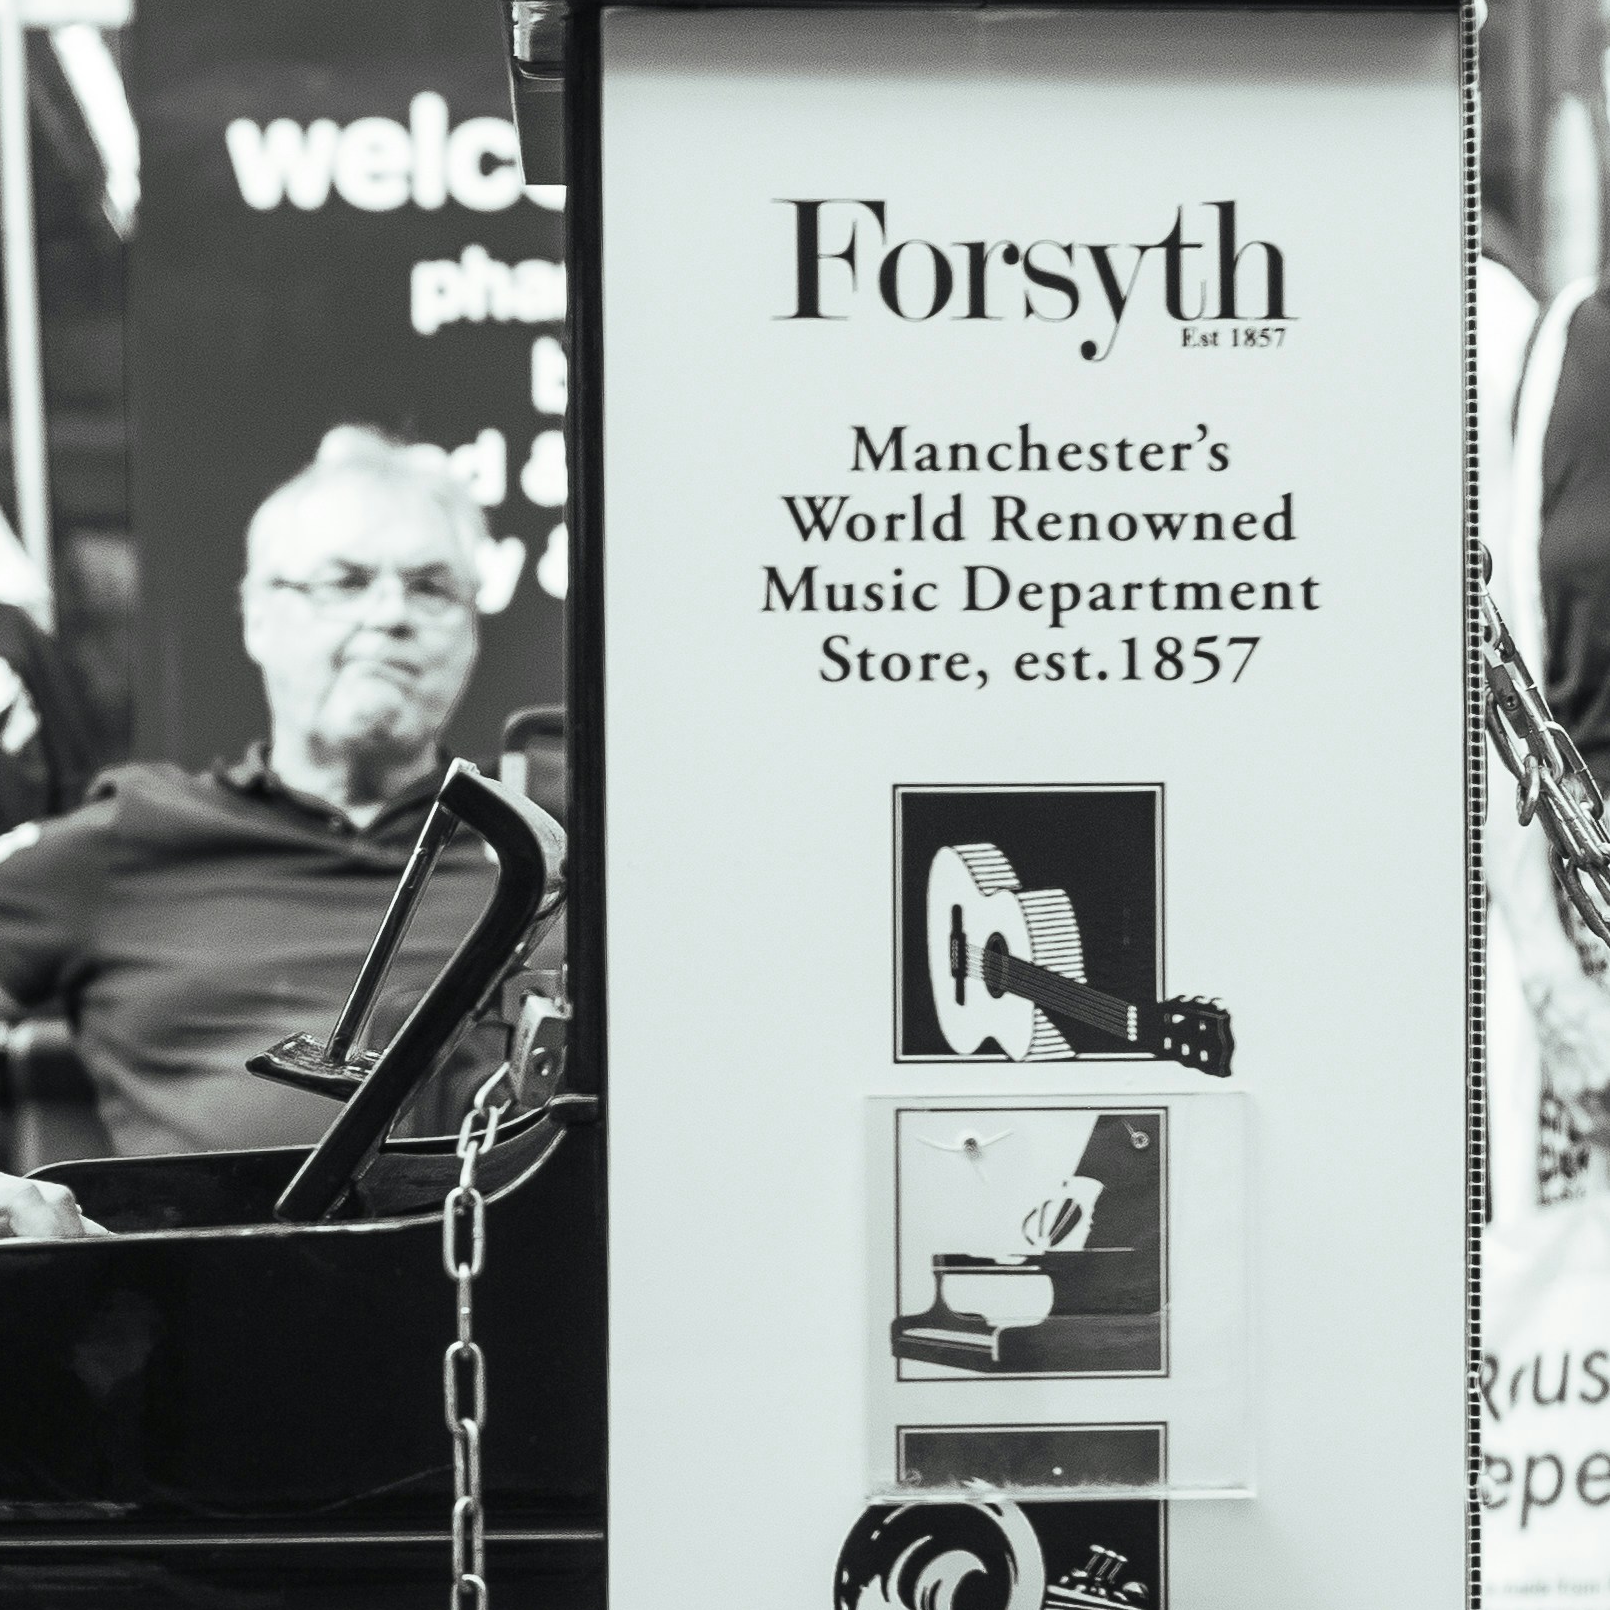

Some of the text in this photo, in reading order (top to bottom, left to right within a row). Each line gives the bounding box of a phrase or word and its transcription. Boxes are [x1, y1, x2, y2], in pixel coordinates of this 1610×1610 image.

[226, 90, 566, 211] welc
[772, 198, 1299, 362] Forsyth
[1181, 326, 1286, 348] Est 1857
[850, 423, 1231, 473] Manchester’s
[781, 493, 1297, 543] World Renowned
[761, 565, 1321, 629] Music Department
[819, 634, 1262, 690] Store, est.1857
